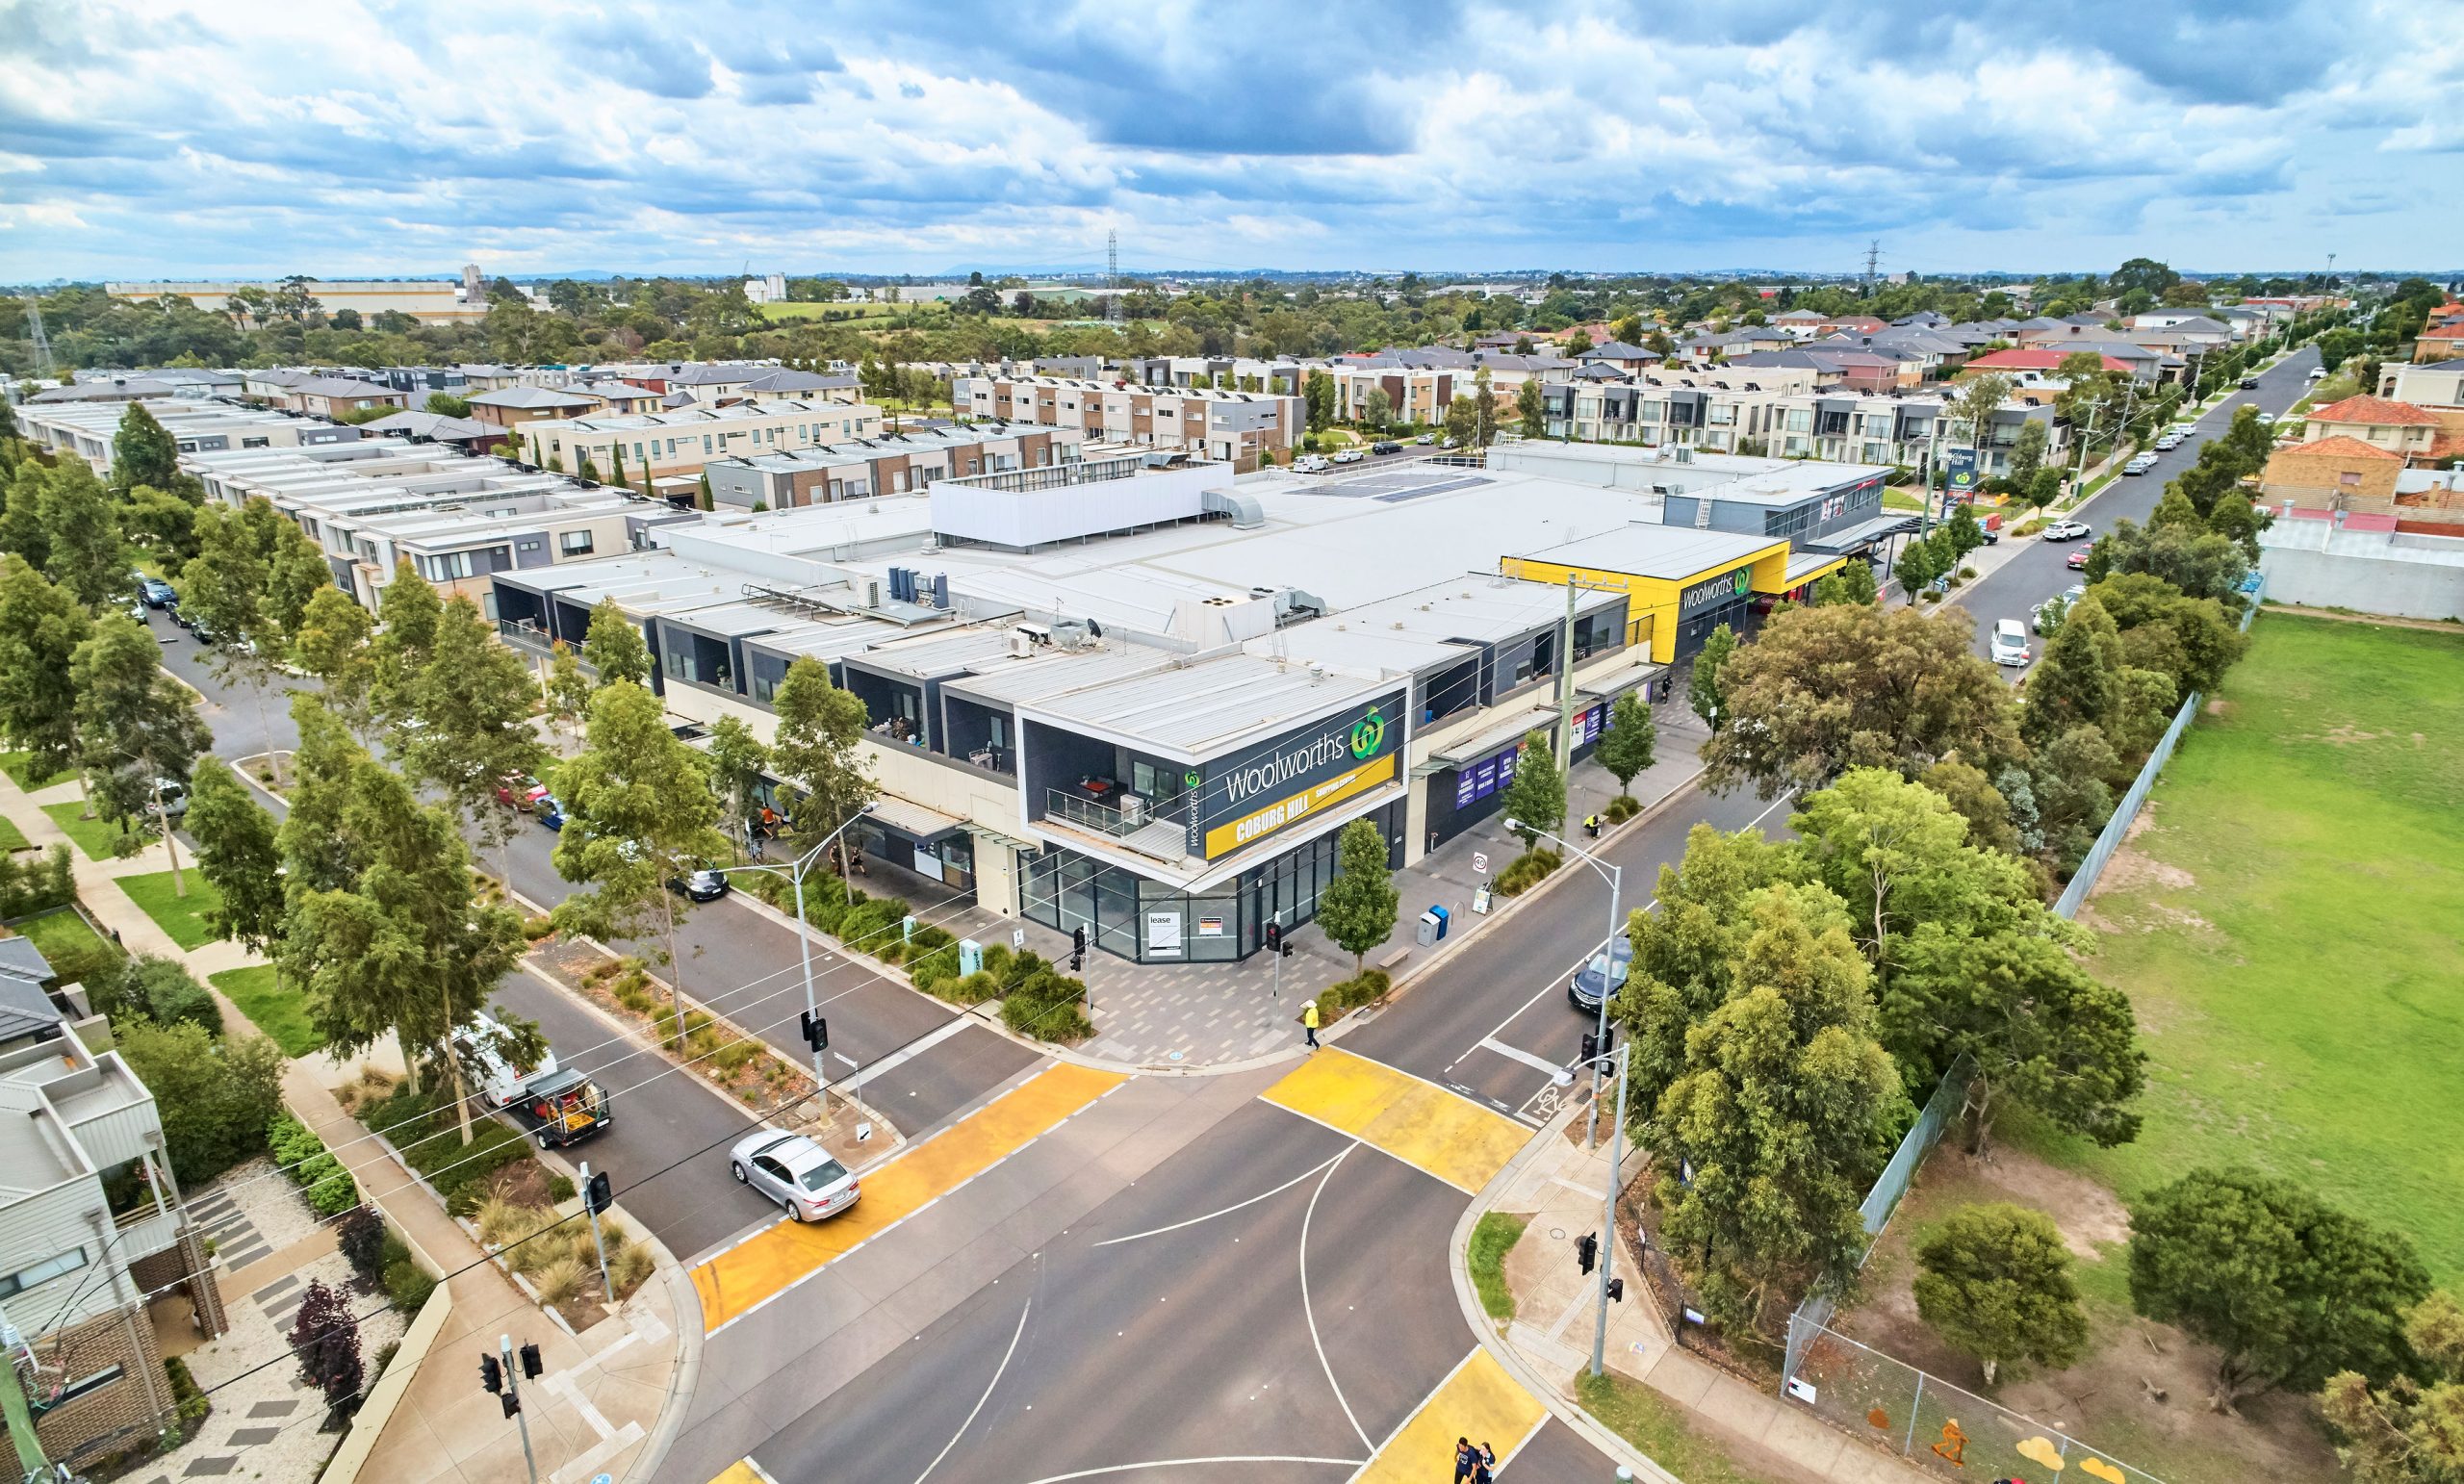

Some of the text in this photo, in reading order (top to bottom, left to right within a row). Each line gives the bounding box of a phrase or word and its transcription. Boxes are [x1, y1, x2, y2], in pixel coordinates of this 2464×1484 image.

[1952, 452, 1973, 462] Coburg
[1682, 574, 1732, 610] Woolworths
[1225, 732, 1345, 803] Woolworths
[1189, 790, 1198, 847] Woolworths
[1236, 794, 1309, 843] COBURG HILL
[1476, 858, 1484, 867] 40
